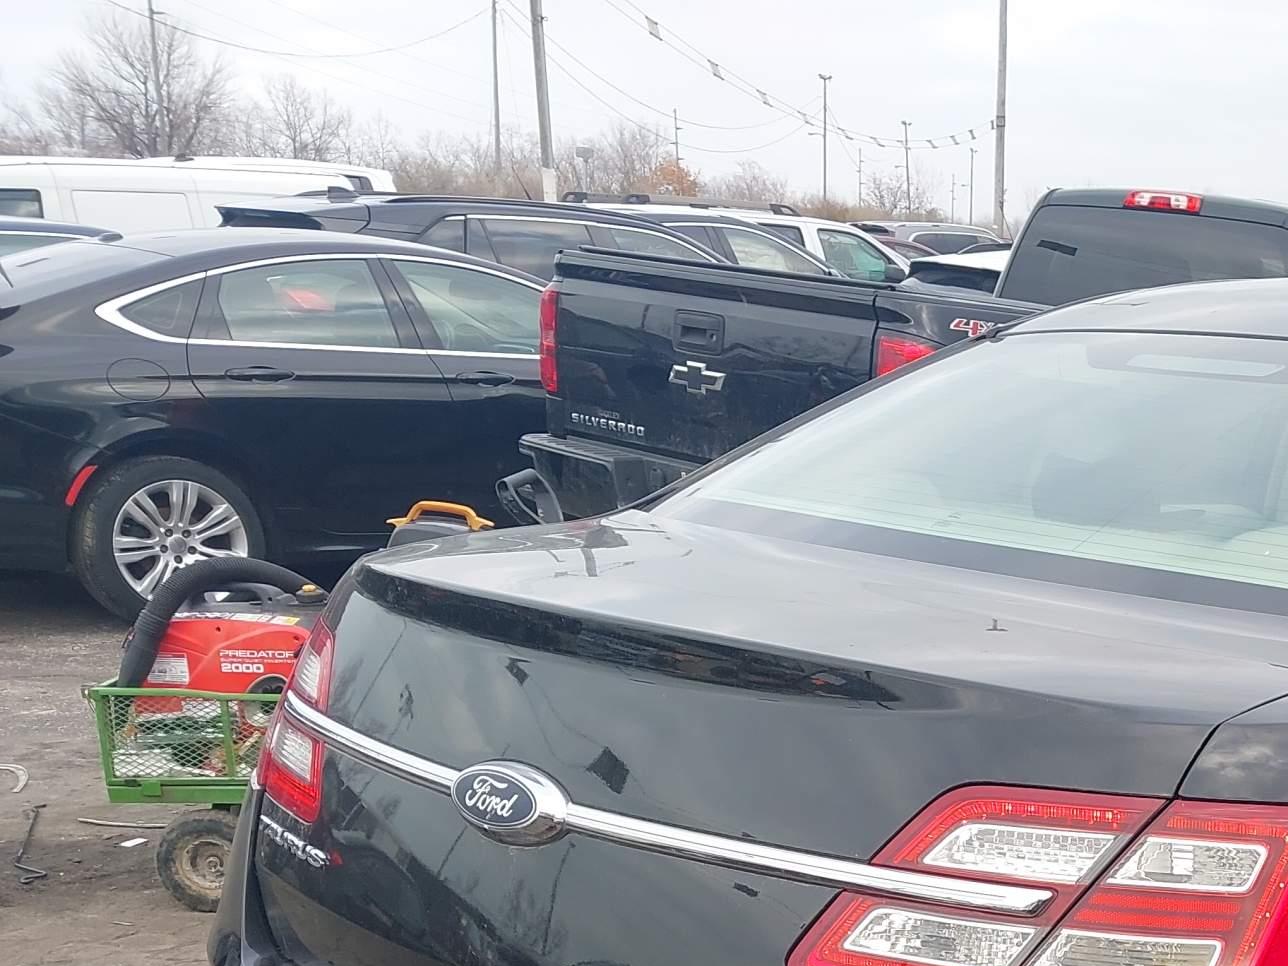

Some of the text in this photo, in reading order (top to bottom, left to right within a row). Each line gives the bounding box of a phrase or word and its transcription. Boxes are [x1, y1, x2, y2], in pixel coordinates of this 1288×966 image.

[571, 412, 645, 436] SILVERADO
[220, 662, 265, 673] 2000
[465, 775, 519, 817] Ford
